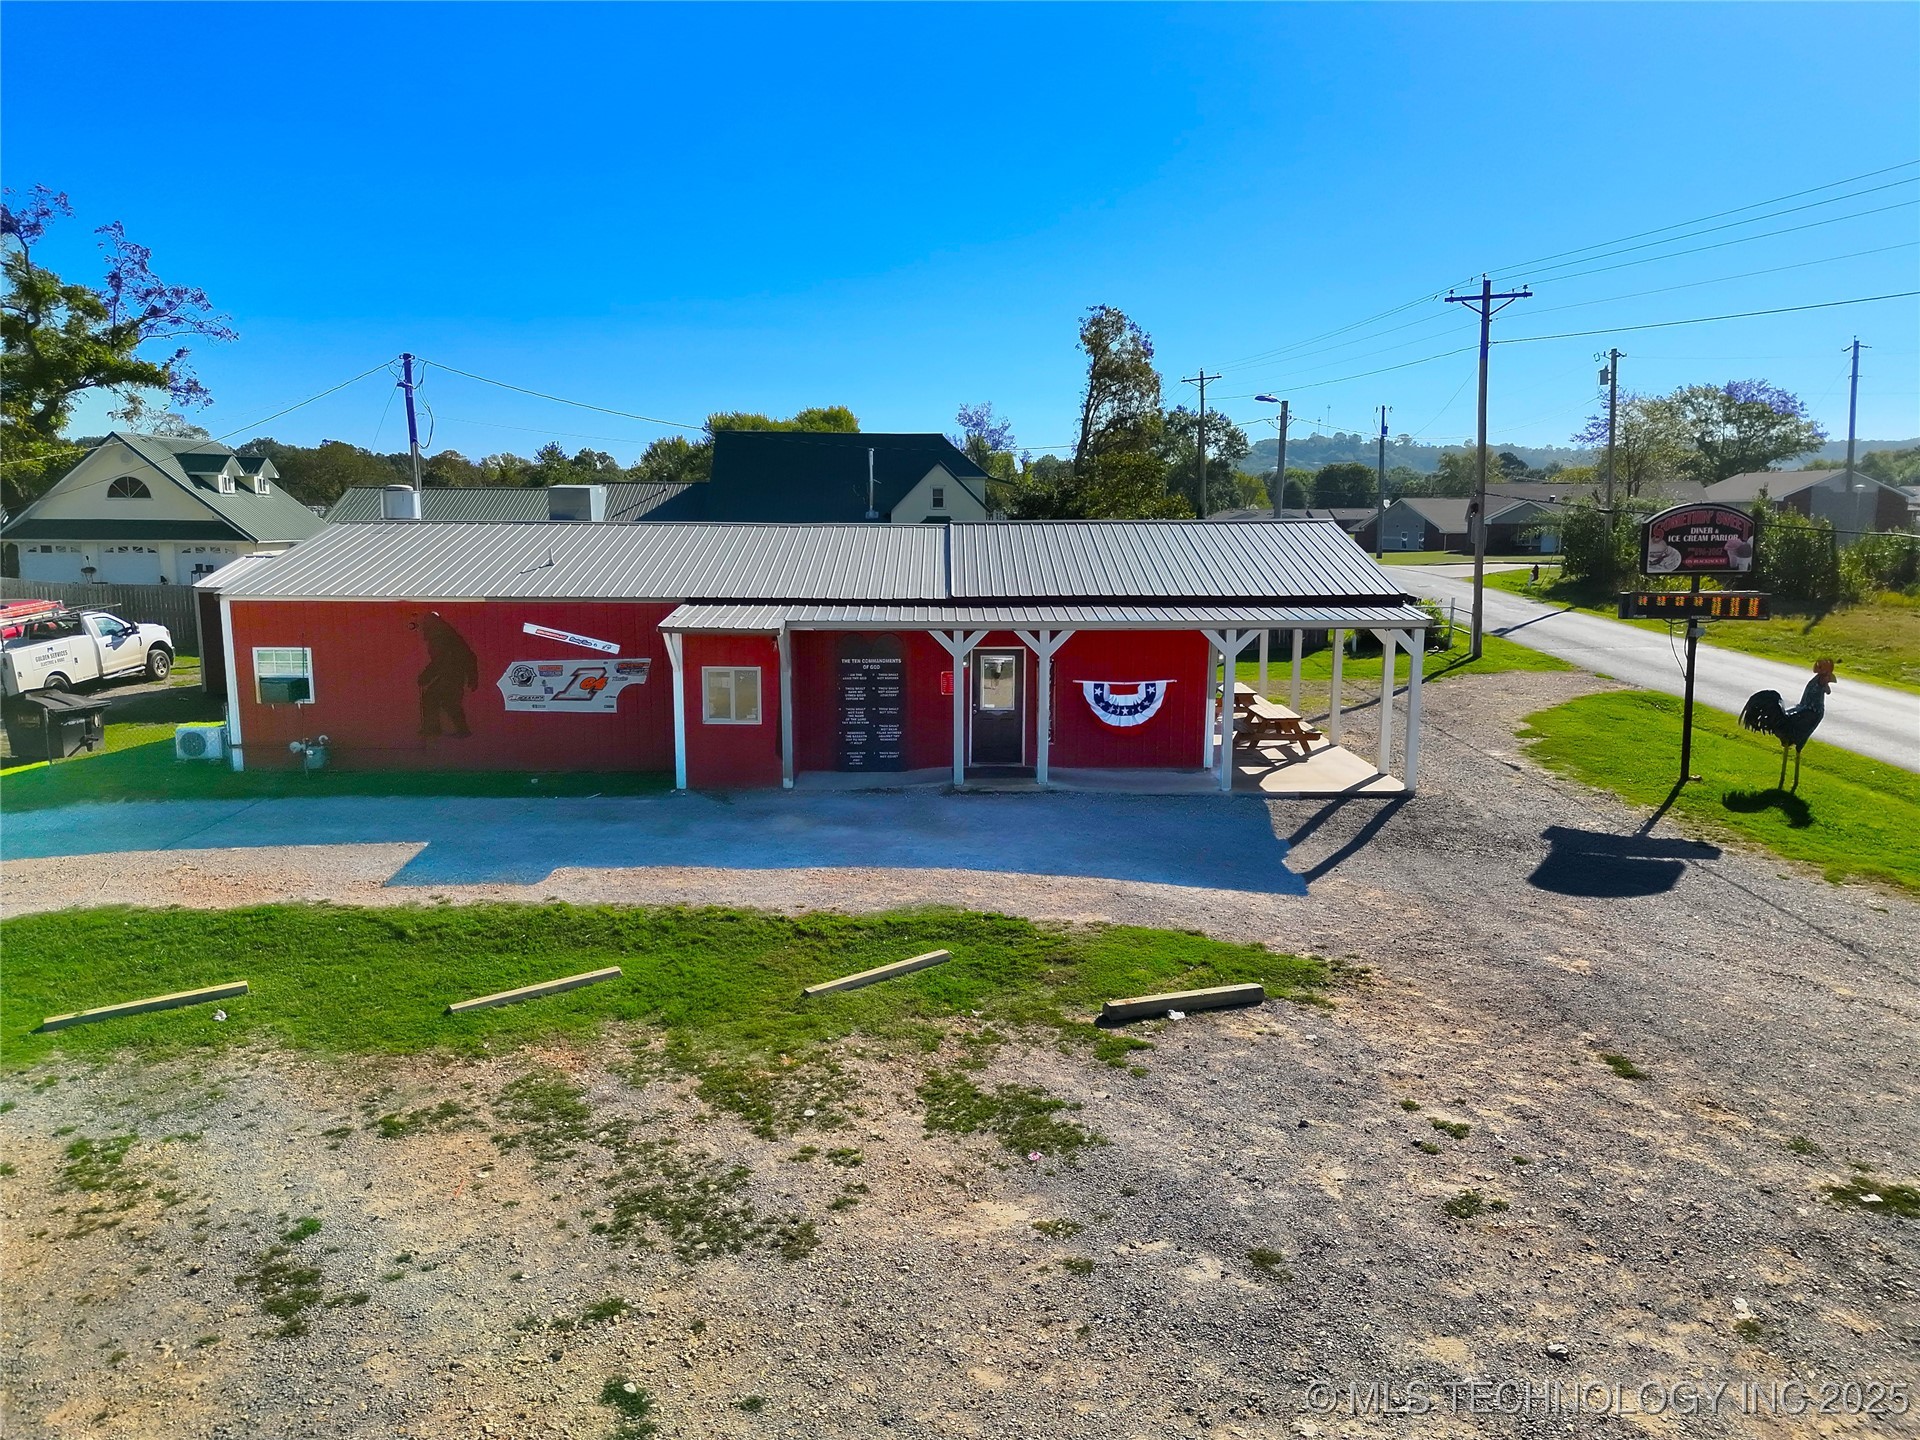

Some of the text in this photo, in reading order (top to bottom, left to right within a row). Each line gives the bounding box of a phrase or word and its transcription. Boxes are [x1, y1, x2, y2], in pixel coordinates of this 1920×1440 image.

[1690, 527, 1713, 535] DINER
[1716, 511, 1751, 541] SWEET
[1683, 534, 1708, 542] CREAM
[1710, 534, 1739, 542] PARLOR
[35, 650, 68, 662] GOLDEN SERVICES
